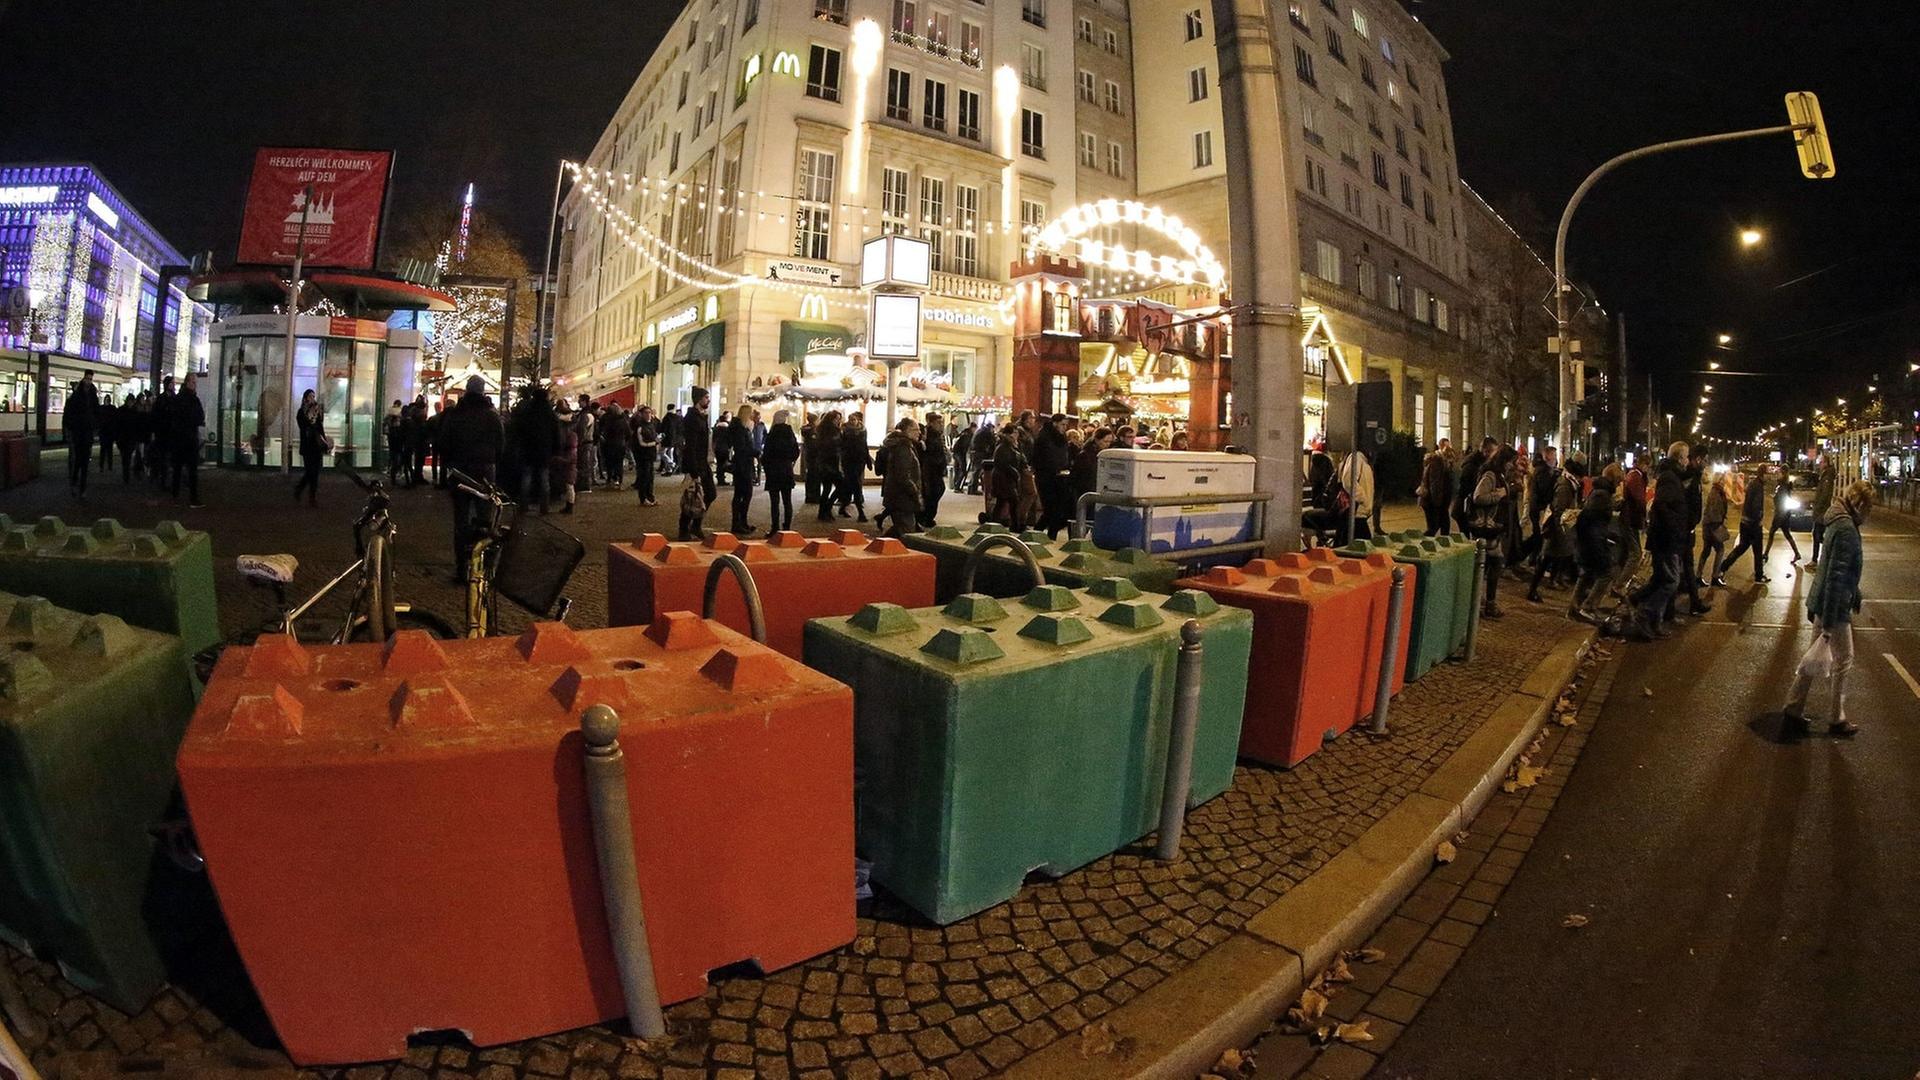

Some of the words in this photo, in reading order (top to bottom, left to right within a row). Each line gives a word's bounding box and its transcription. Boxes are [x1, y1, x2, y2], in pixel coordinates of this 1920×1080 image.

[269, 156, 310, 168] HERZLICH
[312, 158, 373, 171] WILLKOMMEN
[298, 171, 316, 182] AUF
[317, 171, 337, 183] DEM
[284, 223, 332, 235] MAGBURGER
[779, 262, 830, 275] MOVEMENT
[921, 308, 994, 328] cDonald's
